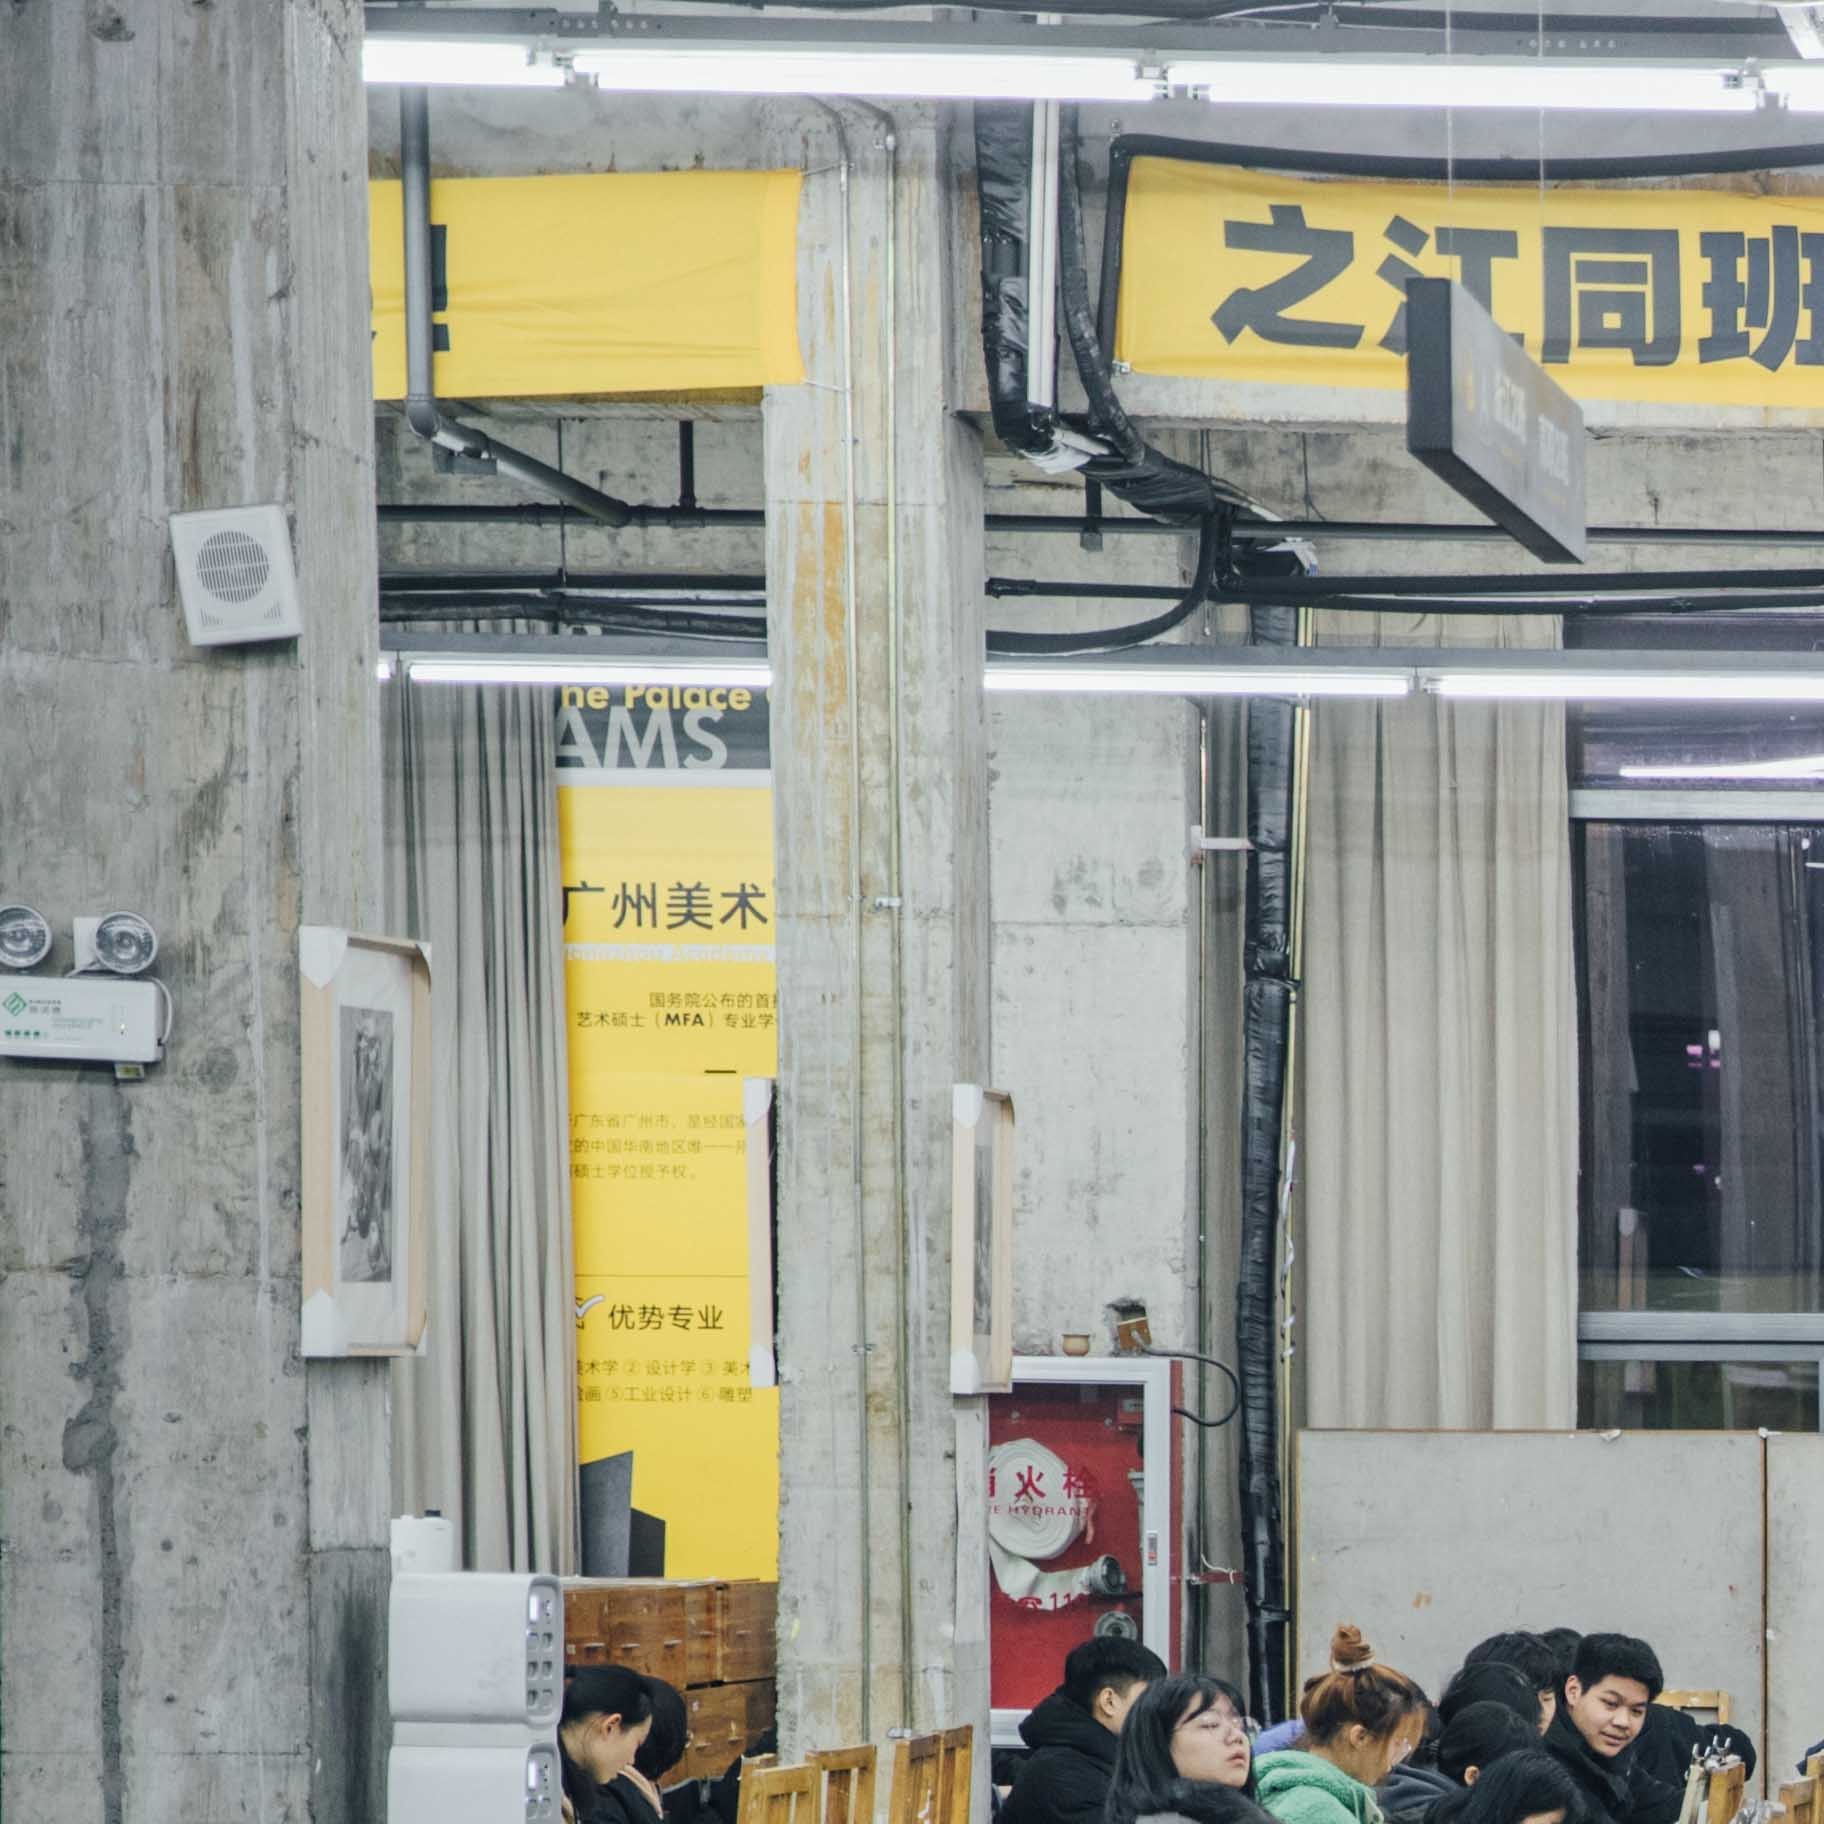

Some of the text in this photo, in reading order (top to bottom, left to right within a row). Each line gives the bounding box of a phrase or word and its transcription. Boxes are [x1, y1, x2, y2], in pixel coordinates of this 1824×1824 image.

[562, 881, 769, 930] 广州美术
[608, 1304, 726, 1331] 优势专业
